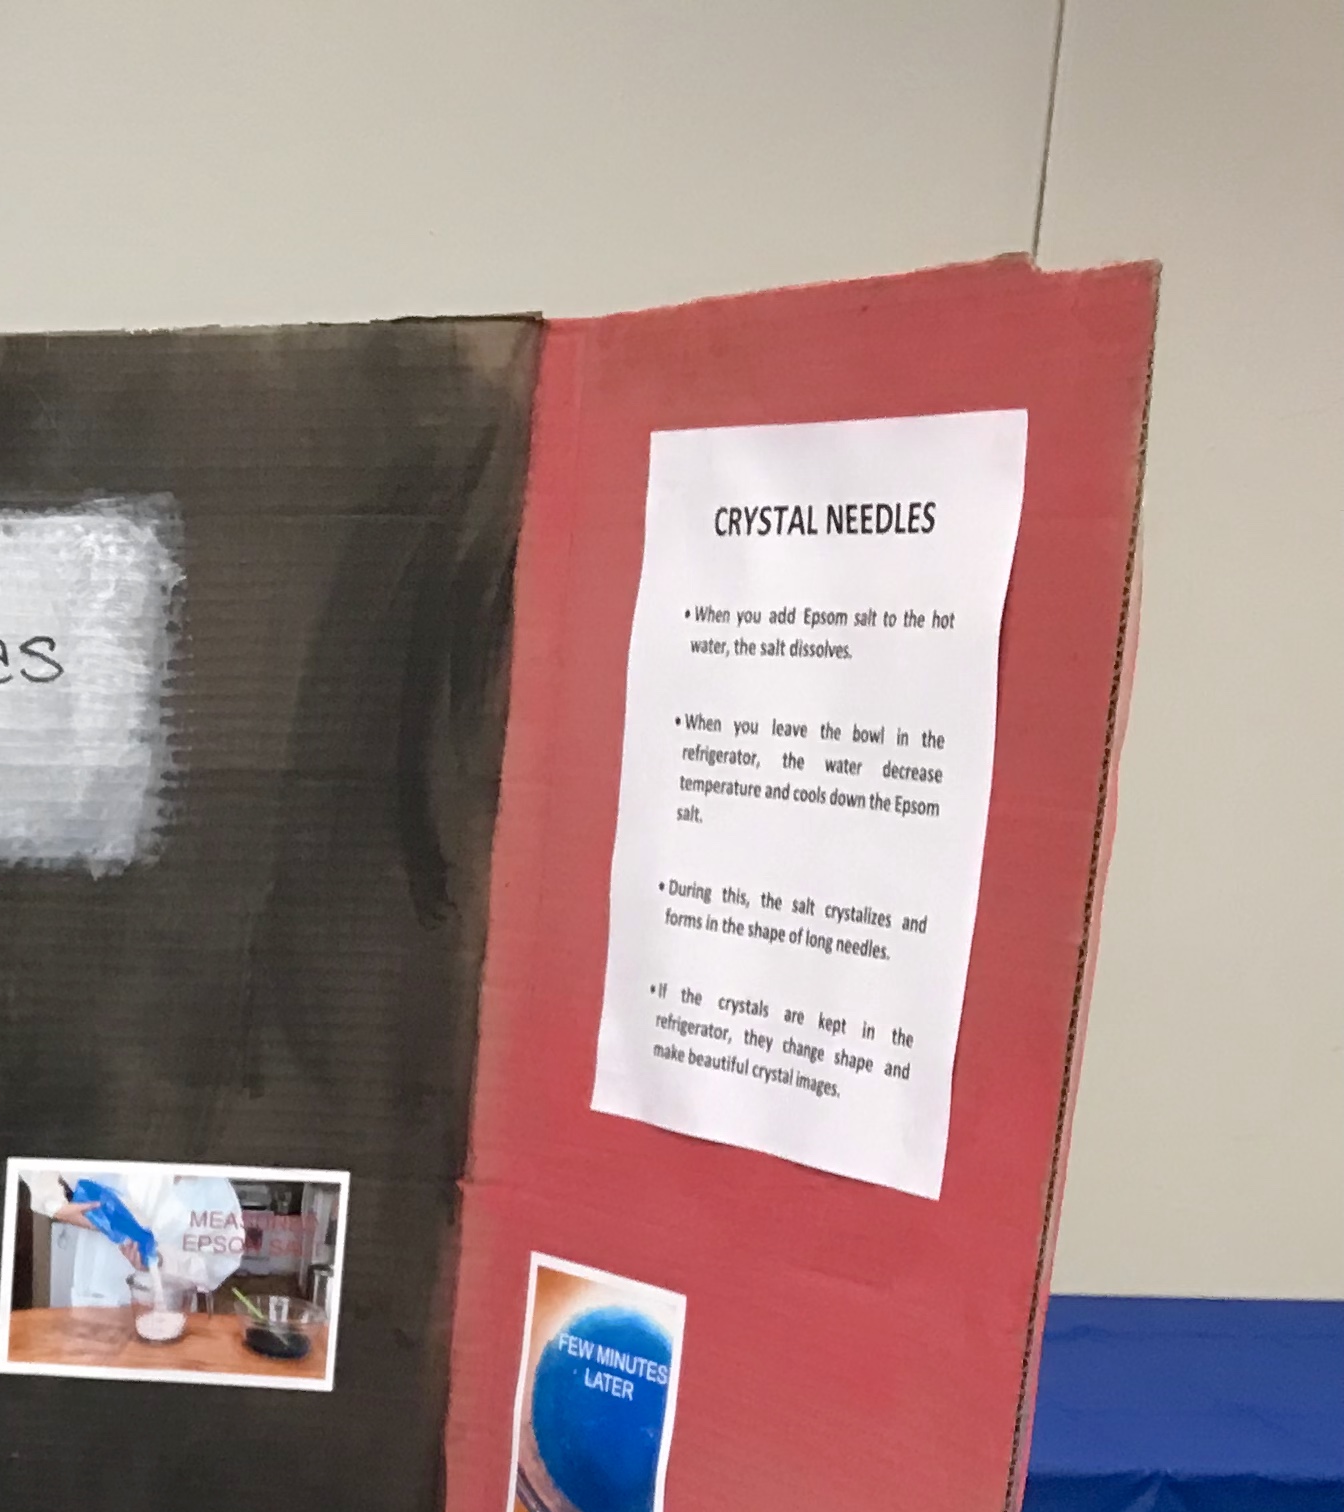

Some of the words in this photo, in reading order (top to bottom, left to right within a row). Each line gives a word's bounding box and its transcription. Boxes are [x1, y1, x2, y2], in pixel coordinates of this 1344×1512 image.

[714, 504, 819, 538] CRYSTAL
[826, 501, 937, 536] NEEDLES
[695, 605, 730, 624] When
[736, 609, 762, 628] you
[769, 606, 796, 625] add
[803, 607, 849, 629] Epsom
[854, 607, 878, 628] salt
[883, 610, 898, 628] to
[903, 609, 926, 629] the
[931, 609, 956, 630] hot
[690, 637, 730, 658] water,
[733, 637, 757, 656] the
[760, 638, 787, 657] salt
[789, 638, 853, 660] dissolves.
[685, 713, 722, 733] When
[733, 720, 760, 738] you
[772, 718, 808, 739] leave
[820, 721, 842, 742] the
[852, 723, 886, 745] bowl
[896, 726, 909, 747] in
[921, 728, 946, 750] the
[681, 744, 761, 770] refrigerator,
[782, 751, 806, 772] the
[824, 758, 864, 777] water
[882, 760, 944, 785] decrease
[676, 804, 704, 824] salt.
[679, 775, 762, 797] temperature
[765, 782, 791, 801] and
[793, 786, 827, 804] cools
[829, 788, 866, 809] down
[869, 792, 892, 812] the
[894, 795, 941, 818] Epsom
[668, 879, 713, 904] During
[721, 885, 751, 909] this,
[760, 891, 783, 912] the
[791, 896, 816, 917] salt
[824, 904, 892, 929] crystalizes
[901, 915, 929, 935] and
[665, 907, 703, 931] forms
[706, 914, 719, 932] in
[722, 916, 745, 936] the
[747, 920, 787, 944] shape
[789, 926, 804, 945] of
[806, 929, 833, 954] long
[836, 937, 891, 961] needles.
[658, 982, 668, 1000] If
[680, 986, 703, 1007] the
[717, 996, 770, 1019] crystals
[783, 1007, 805, 1026] are
[817, 1011, 848, 1037] kept
[861, 1020, 876, 1041] in
[891, 1026, 914, 1049] the
[655, 1012, 733, 1045] refrigerator,
[743, 1029, 774, 1054] they
[782, 1036, 825, 1065] change
[833, 1048, 874, 1075] shape
[883, 1060, 911, 1081] and
[653, 1043, 686, 1064] make
[688, 1047, 750, 1076] beautiful
[752, 1067, 795, 1085] crystal
[795, 1070, 842, 1099] images.
[558, 1332, 594, 1361] FEW
[596, 1344, 669, 1385] MINUTES
[584, 1366, 635, 1402] LATER
